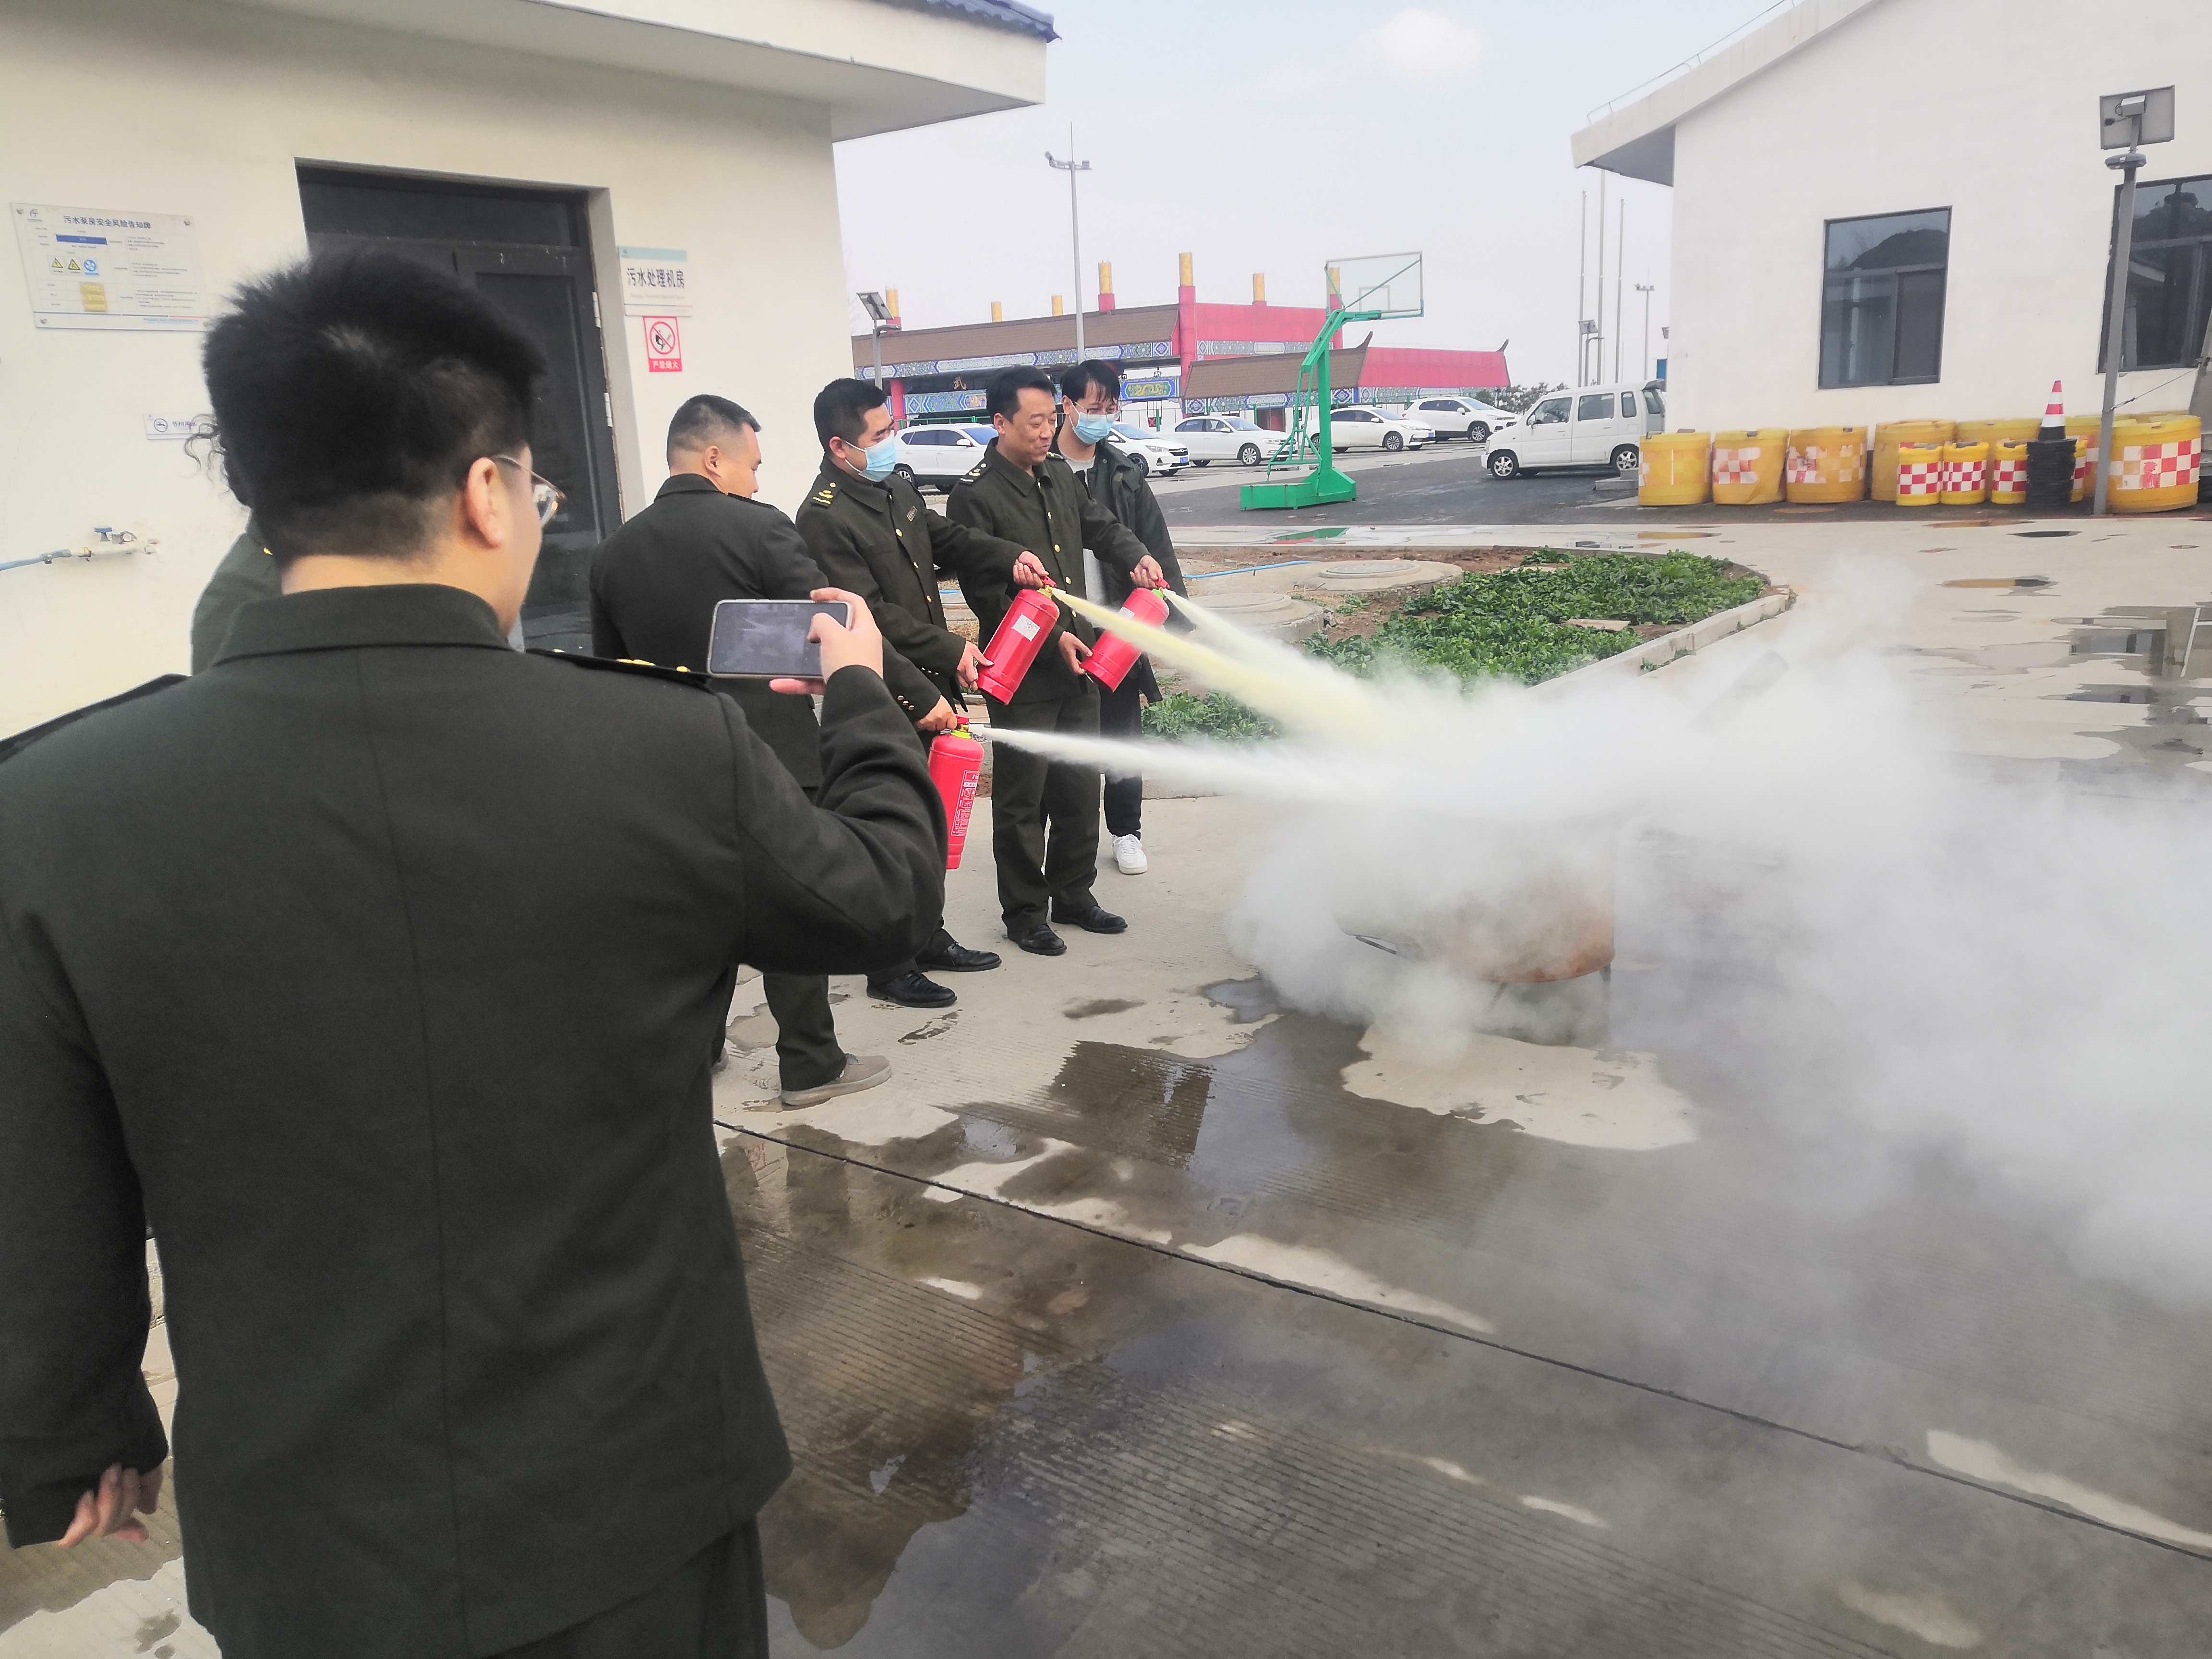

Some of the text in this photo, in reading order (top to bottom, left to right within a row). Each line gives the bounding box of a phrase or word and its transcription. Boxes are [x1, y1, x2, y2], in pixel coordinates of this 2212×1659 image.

[63, 216, 151, 229] 污水泵房安全风险告知牌
[627, 267, 685, 289] 污水处理机房
